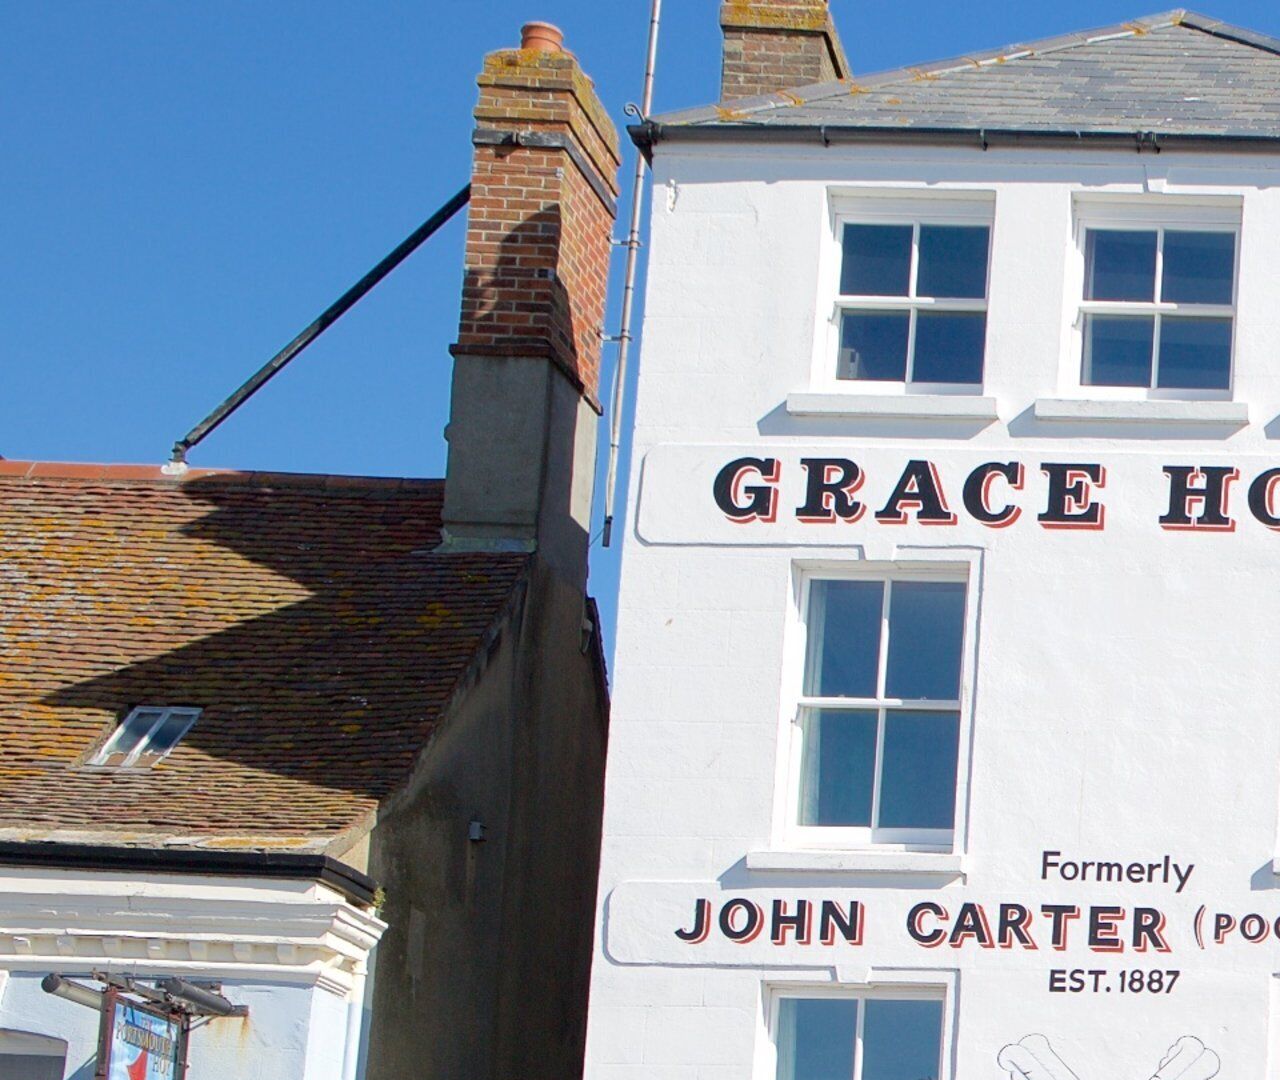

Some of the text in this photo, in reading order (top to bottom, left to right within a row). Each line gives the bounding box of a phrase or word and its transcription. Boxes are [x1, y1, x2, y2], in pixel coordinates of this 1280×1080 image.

[713, 457, 1106, 531] GRACE
[1042, 850, 1195, 894] Formerly
[674, 897, 864, 945] JOHN
[906, 900, 1167, 952] CARTER
[1048, 968, 1180, 995] EST. 1887
[152, 1055, 171, 1076] HOY
